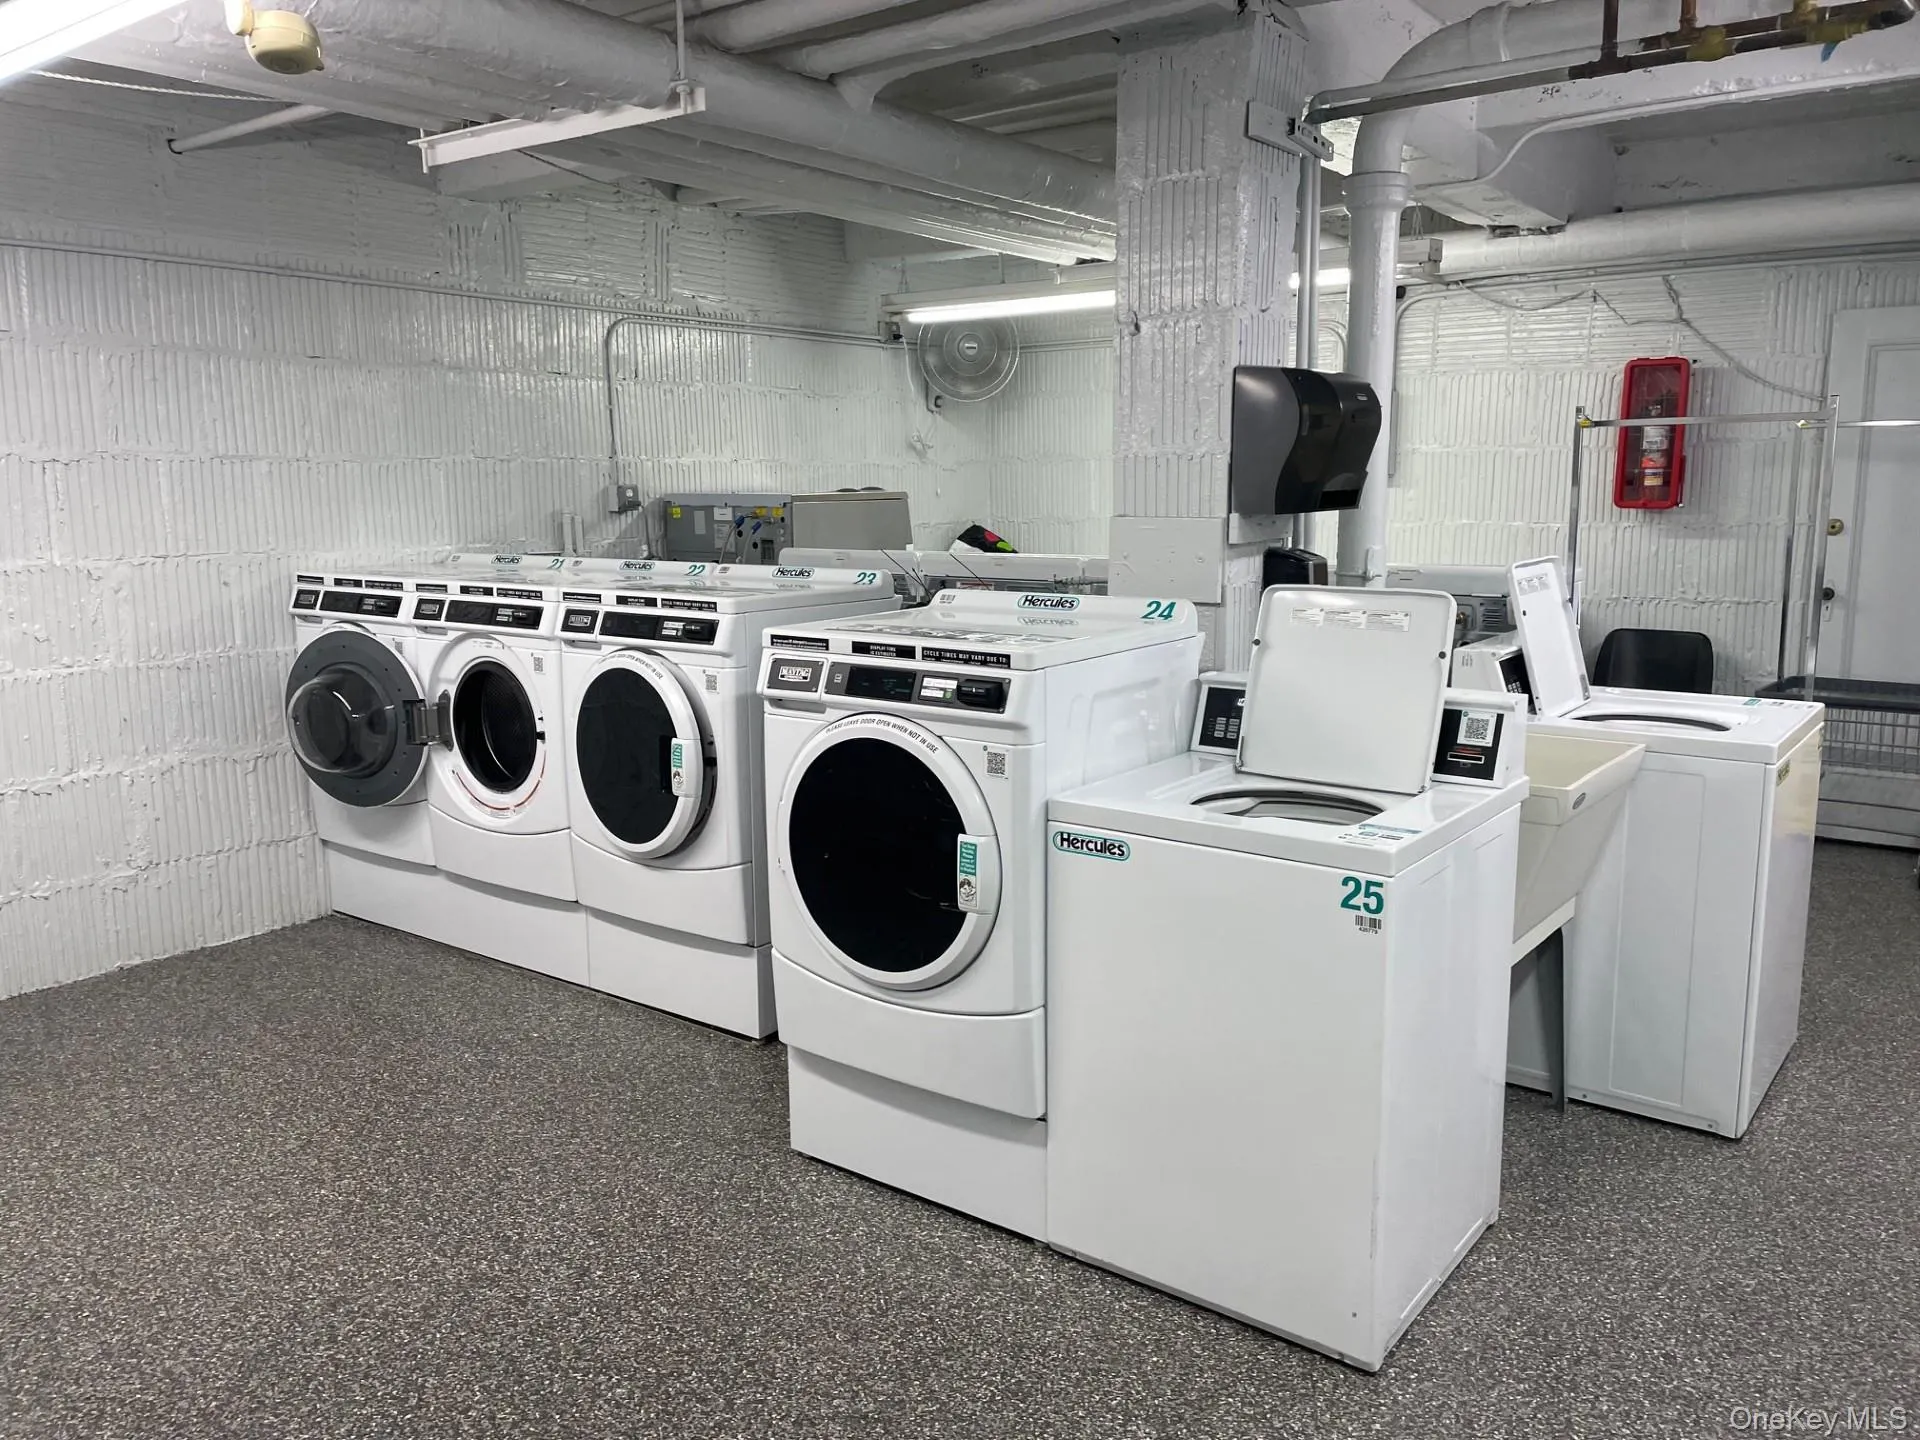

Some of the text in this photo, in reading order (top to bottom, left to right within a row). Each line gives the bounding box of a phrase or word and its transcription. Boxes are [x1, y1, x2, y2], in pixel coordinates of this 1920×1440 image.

[494, 555, 520, 564] Hercules
[546, 558, 566, 570] 21
[622, 561, 652, 570] Hercules
[684, 564, 706, 576] 22
[776, 567, 812, 577] Hercules
[853, 572, 877, 585] 23
[1022, 595, 1075, 609] Hercules
[1141, 600, 1177, 620] 24
[876, 718, 890, 727] OPEN
[891, 722, 908, 734] WHEN
[907, 729, 921, 741] NOT
[919, 736, 927, 745] IN
[926, 741, 939, 754] USE
[1060, 832, 1125, 857] Hercules
[1341, 876, 1384, 915] 25
